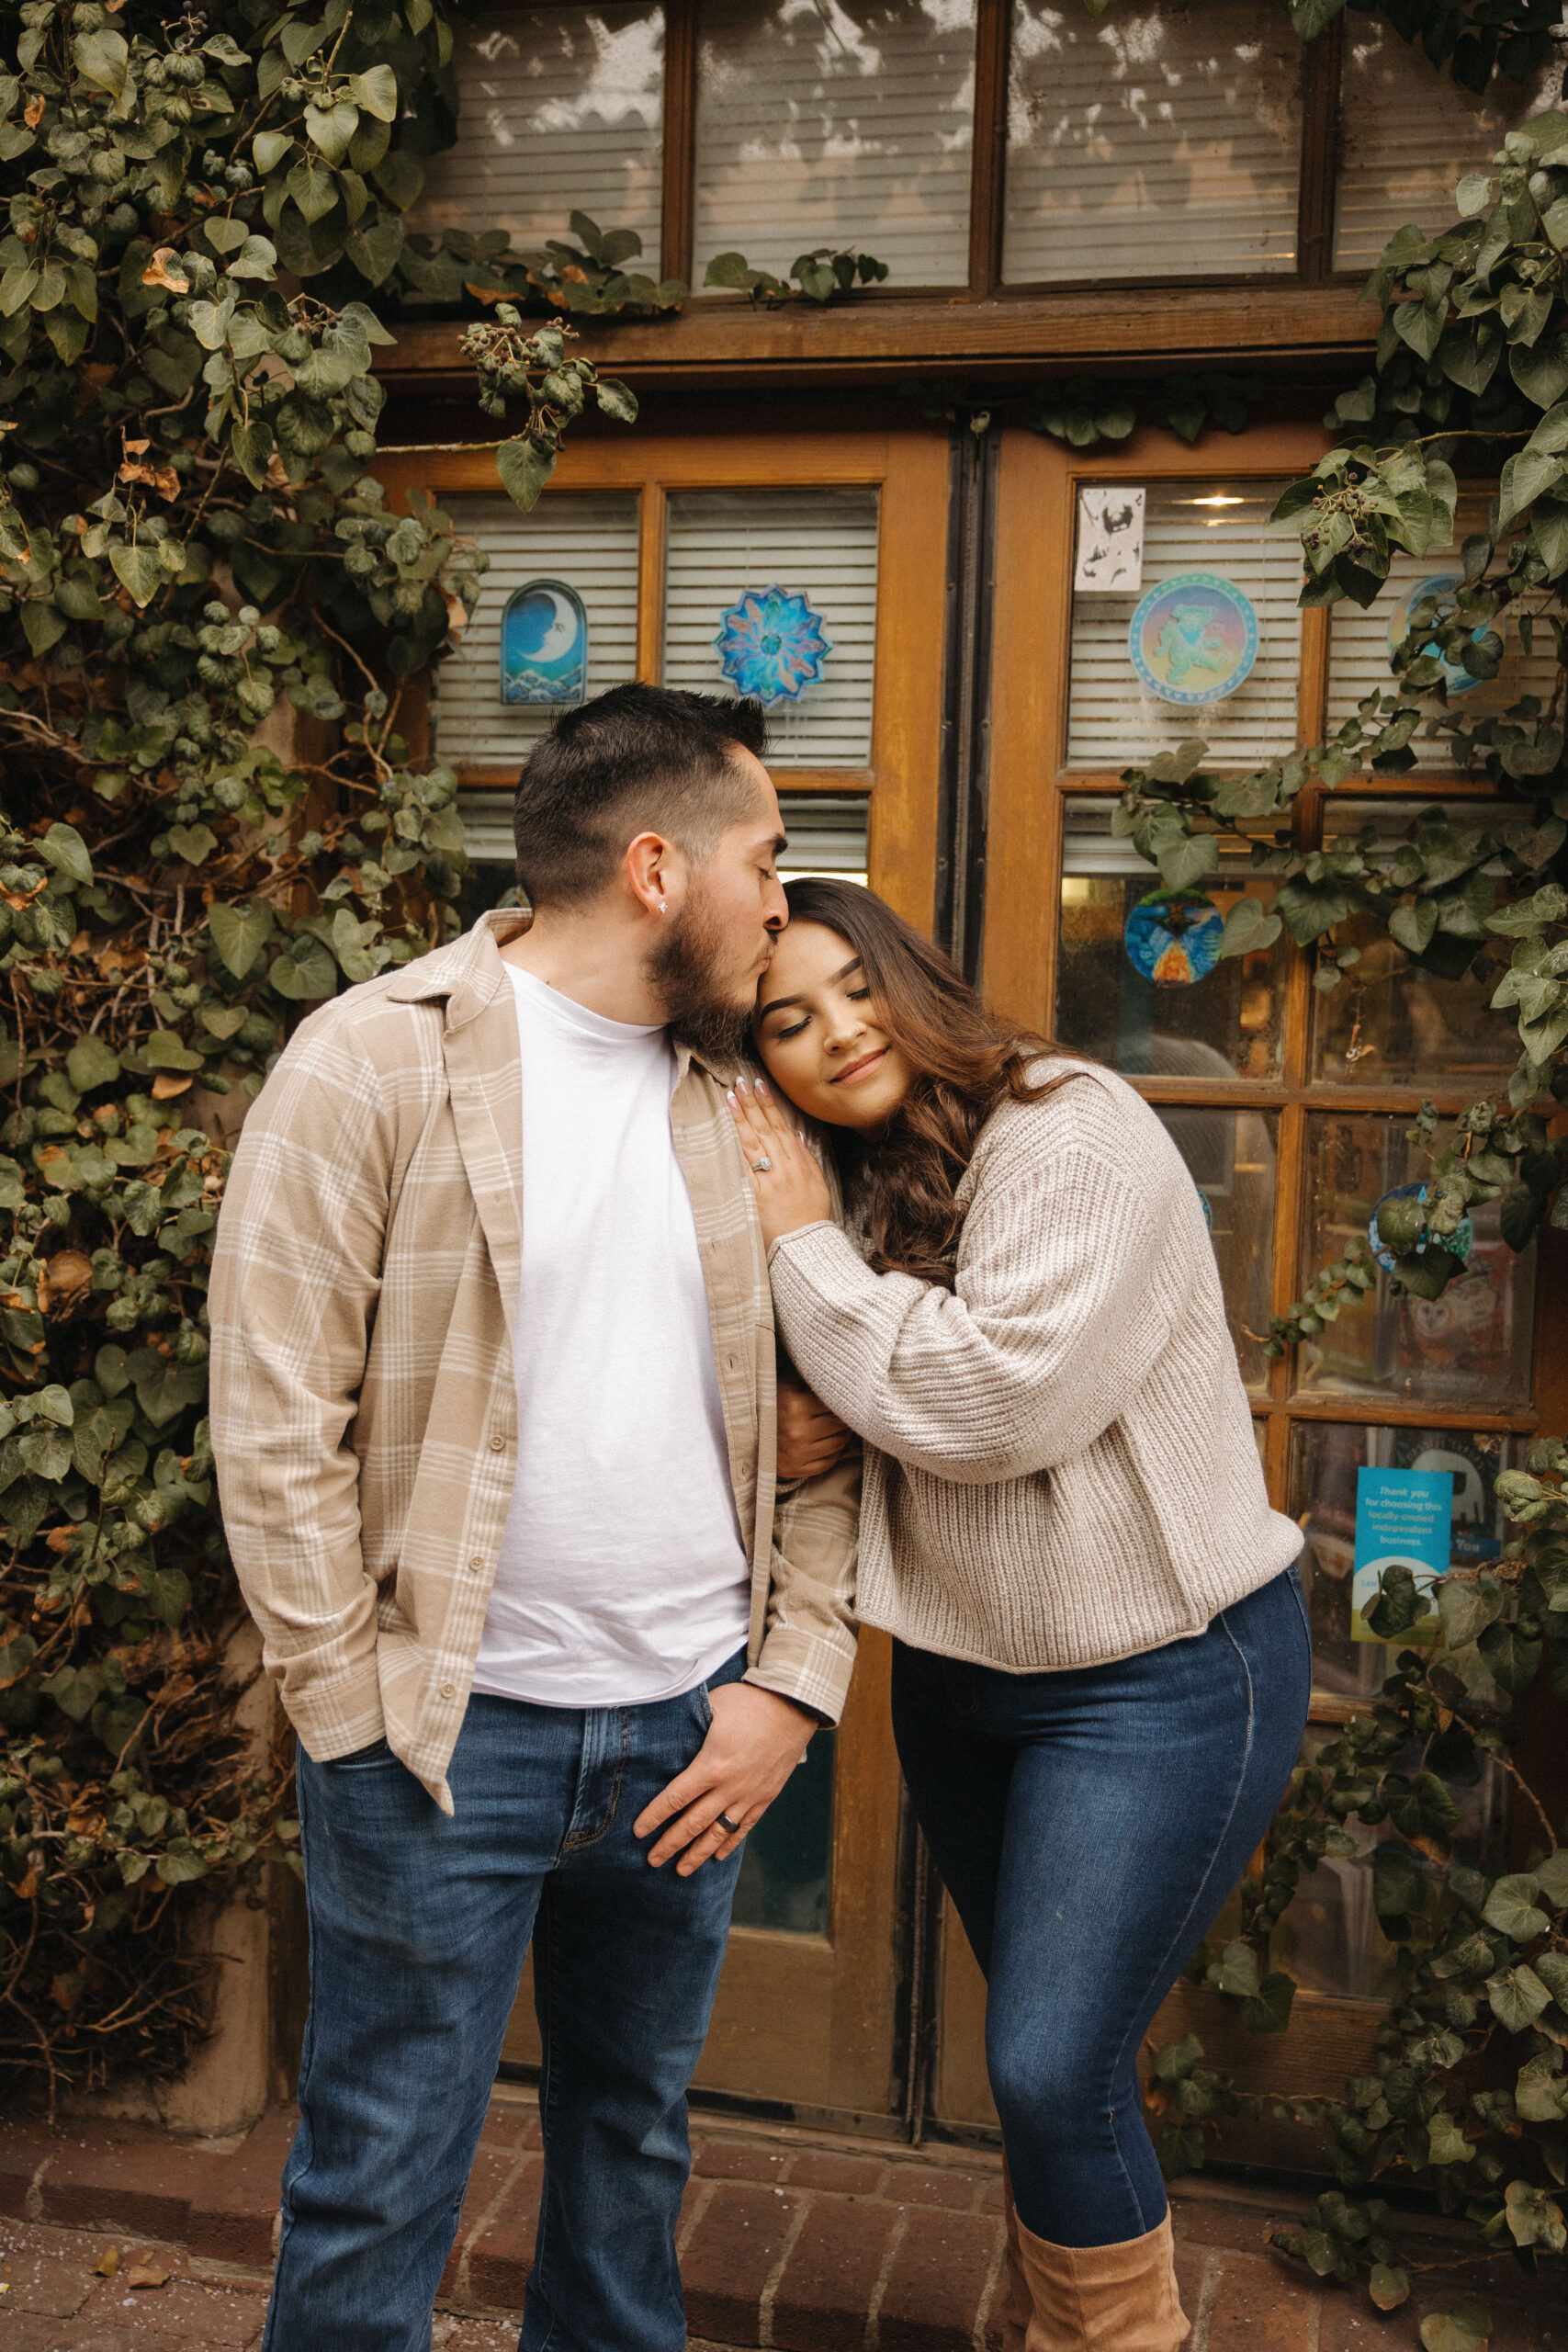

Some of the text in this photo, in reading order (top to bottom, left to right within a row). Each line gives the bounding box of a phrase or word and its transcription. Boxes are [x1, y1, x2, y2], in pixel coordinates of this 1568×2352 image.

[1380, 1486, 1429, 1498] Thank you
[1365, 1498, 1442, 1512] for choosing this
[1371, 1523, 1433, 1534] independent
[1454, 1538, 1480, 1553] You
